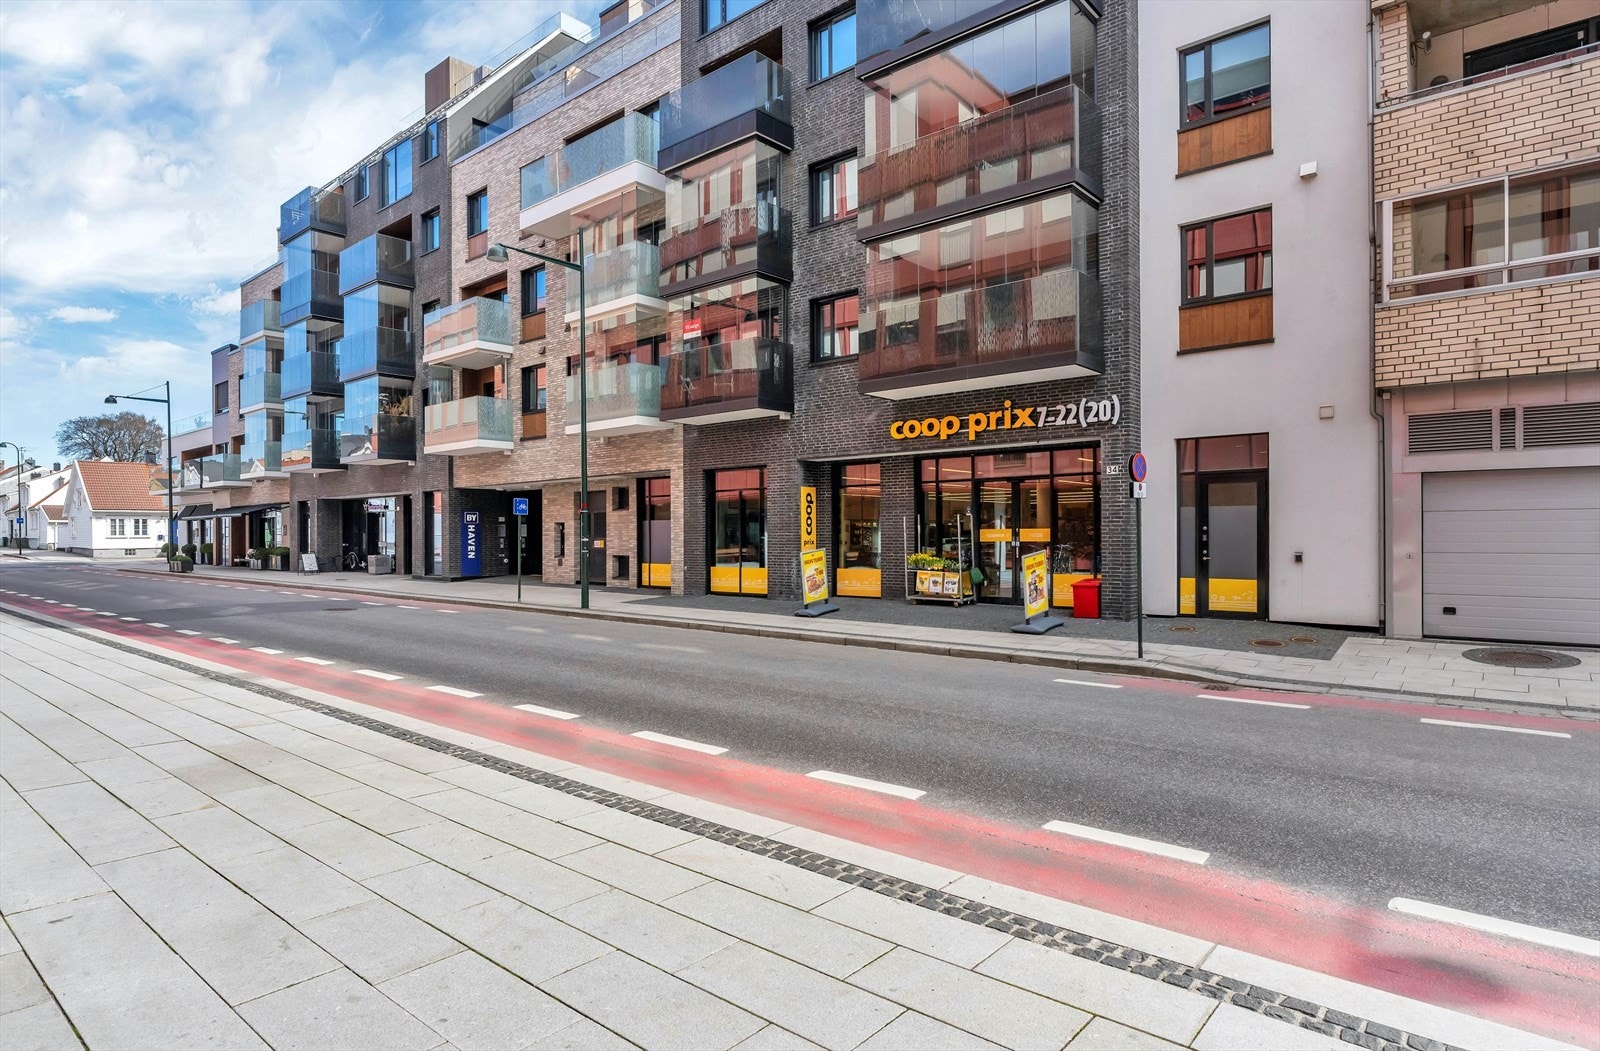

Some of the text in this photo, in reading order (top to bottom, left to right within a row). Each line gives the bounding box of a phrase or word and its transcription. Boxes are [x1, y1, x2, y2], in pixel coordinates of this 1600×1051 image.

[890, 415, 960, 440] coop
[969, 400, 1036, 440] prix
[806, 493, 814, 536] coop
[468, 525, 476, 559] HAVEN
[804, 538, 814, 547] prix
